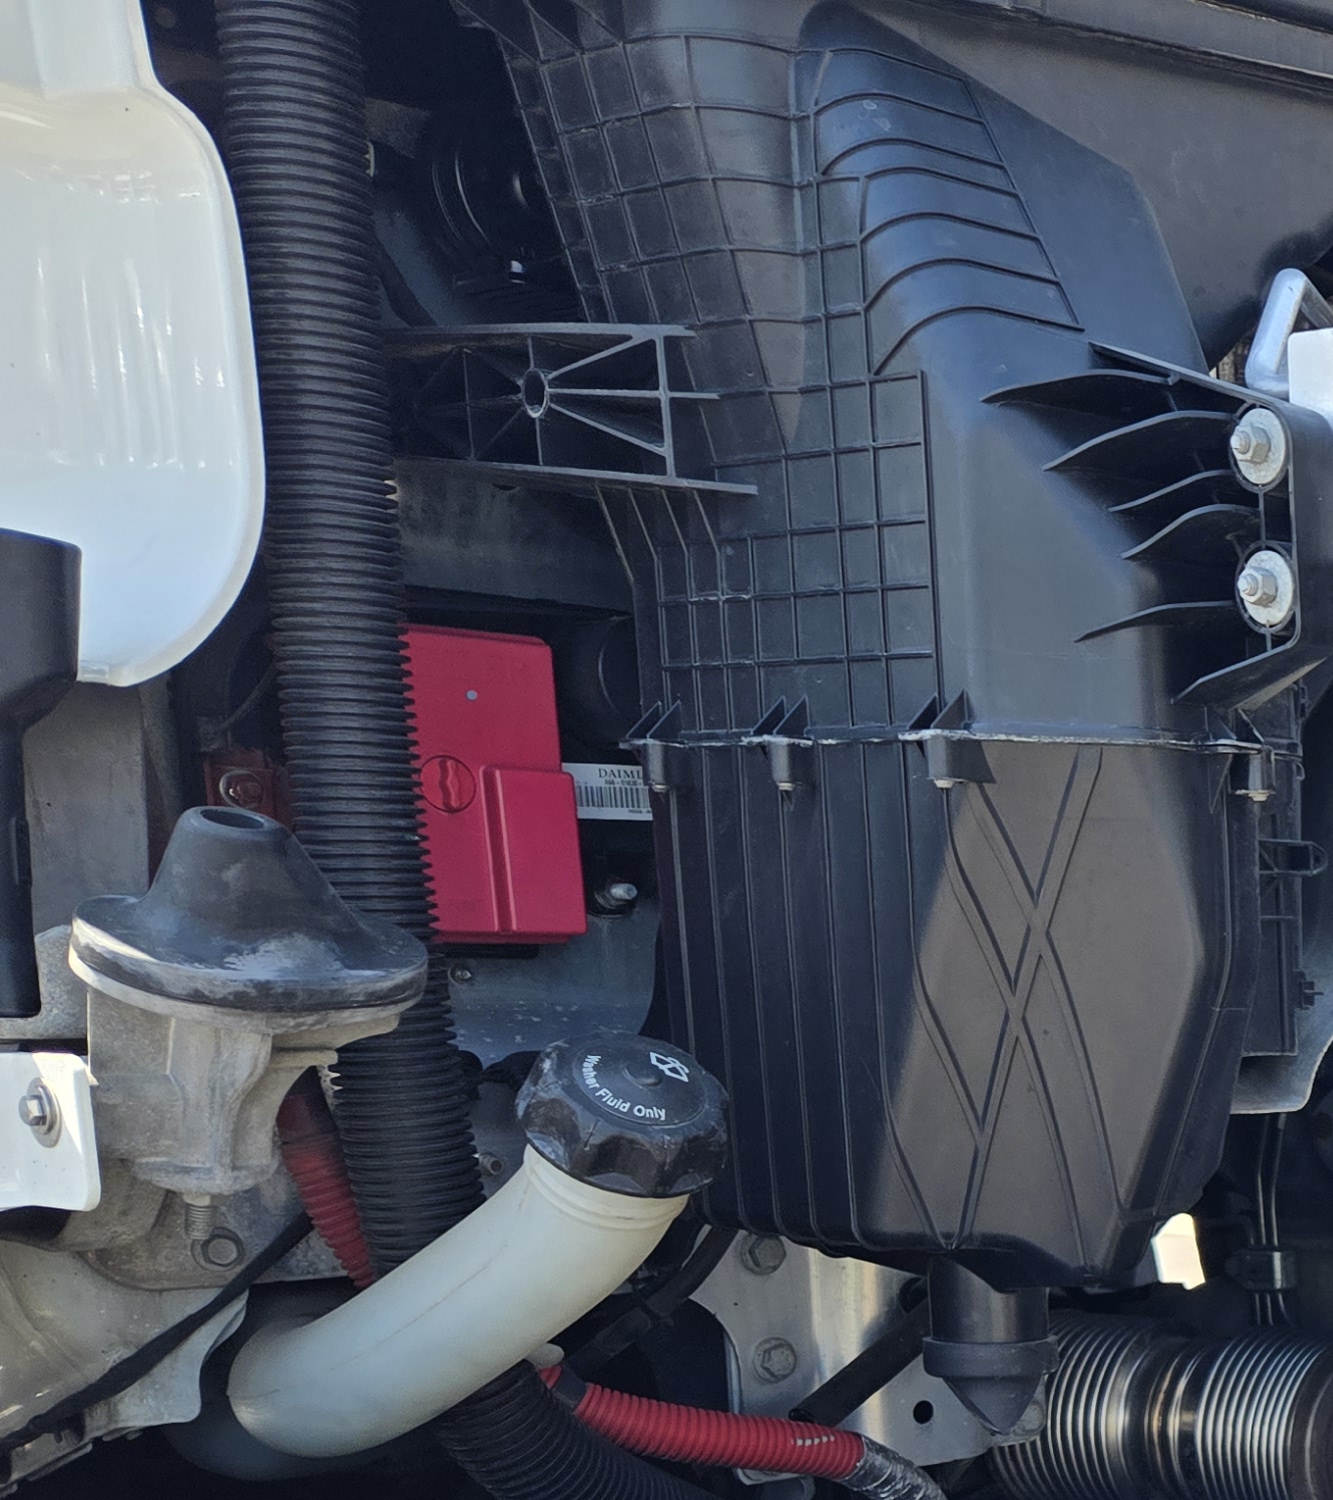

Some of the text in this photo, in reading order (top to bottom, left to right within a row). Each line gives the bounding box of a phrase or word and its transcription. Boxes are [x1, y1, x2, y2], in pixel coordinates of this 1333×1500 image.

[582, 1055, 666, 1121] Washer Fluid Only
